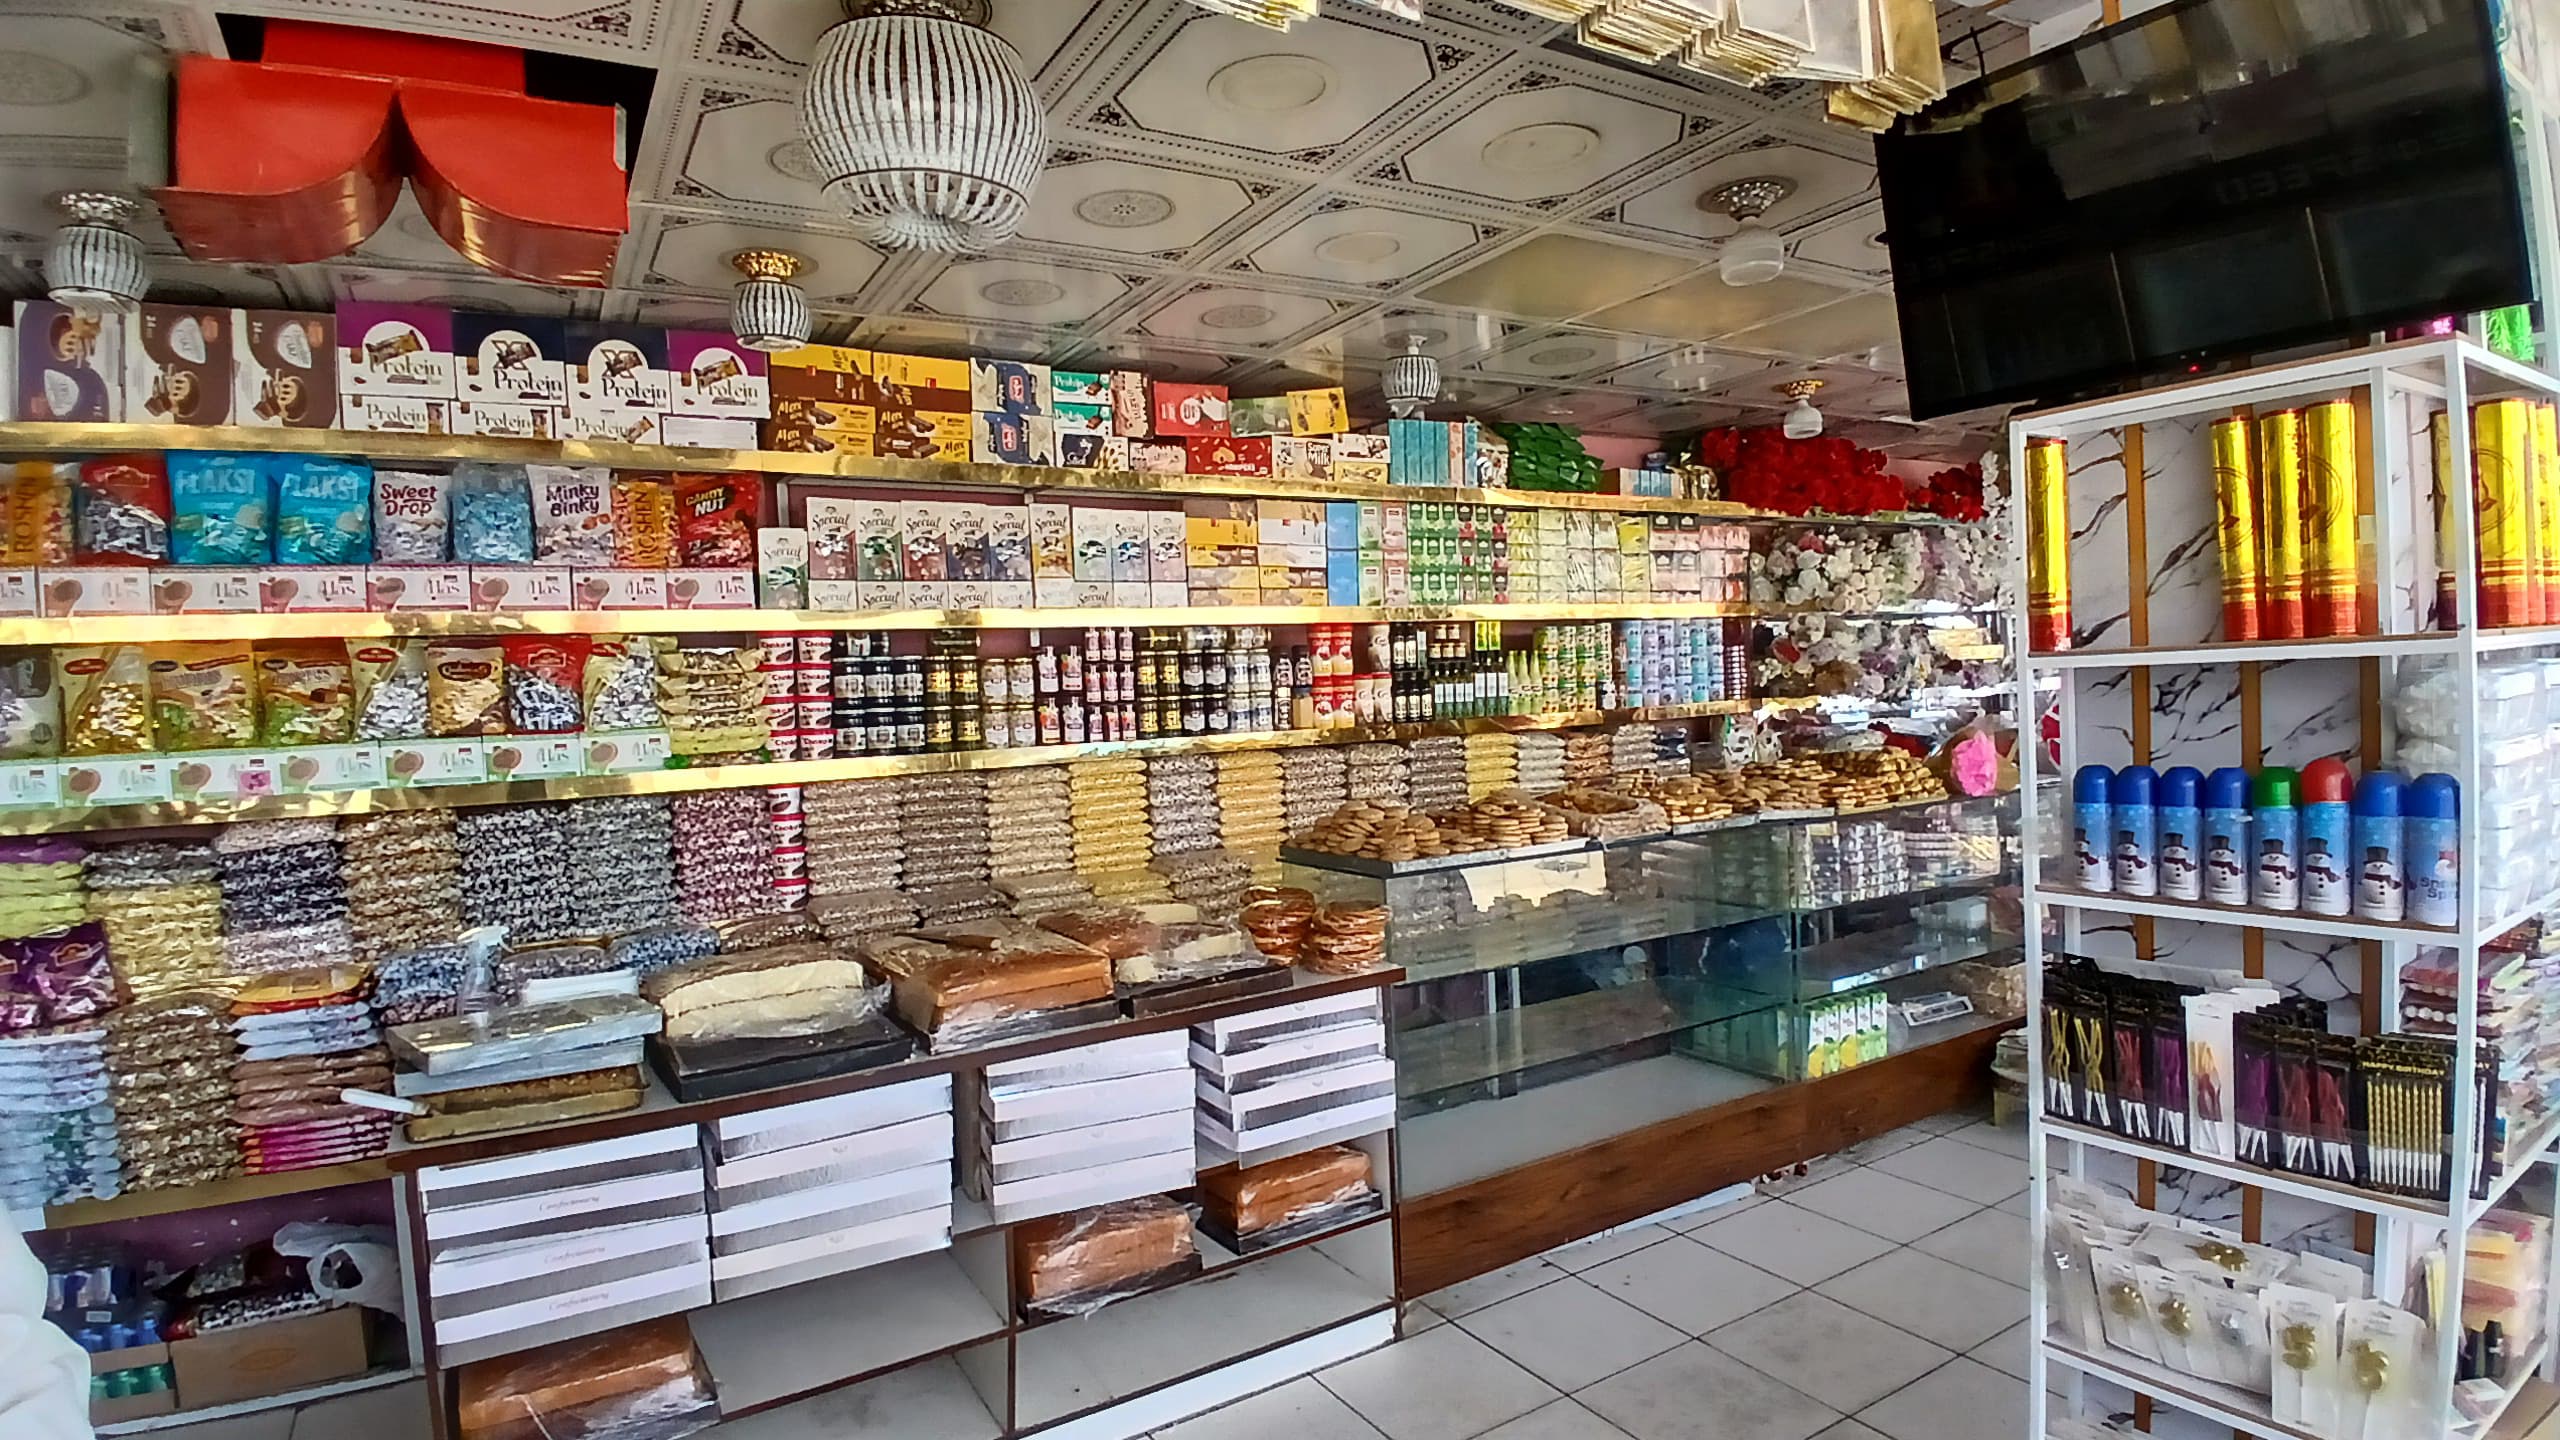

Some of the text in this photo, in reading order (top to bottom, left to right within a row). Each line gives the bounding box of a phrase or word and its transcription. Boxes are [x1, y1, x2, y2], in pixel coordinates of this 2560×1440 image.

[493, 368, 563, 392] Protein
[602, 376, 668, 399] Protein
[366, 401, 428, 423] Protein
[474, 409, 534, 429] Protein
[1308, 450, 1331, 466] Milk
[380, 483, 438, 499] Sweet
[546, 483, 600, 502] Minky
[686, 486, 726, 506] CANDY
[14, 478, 38, 552] ROSHEN
[385, 500, 432, 517] Drop
[694, 497, 726, 517] NUT
[637, 490, 658, 560] ROSHEN
[812, 513, 850, 531] Special
[906, 515, 942, 534] Special
[949, 516, 984, 535] Special
[992, 518, 1027, 536] Special
[1034, 516, 1068, 533] Special
[2362, 1061, 2445, 1076] HAPPY BIRTHDAY
